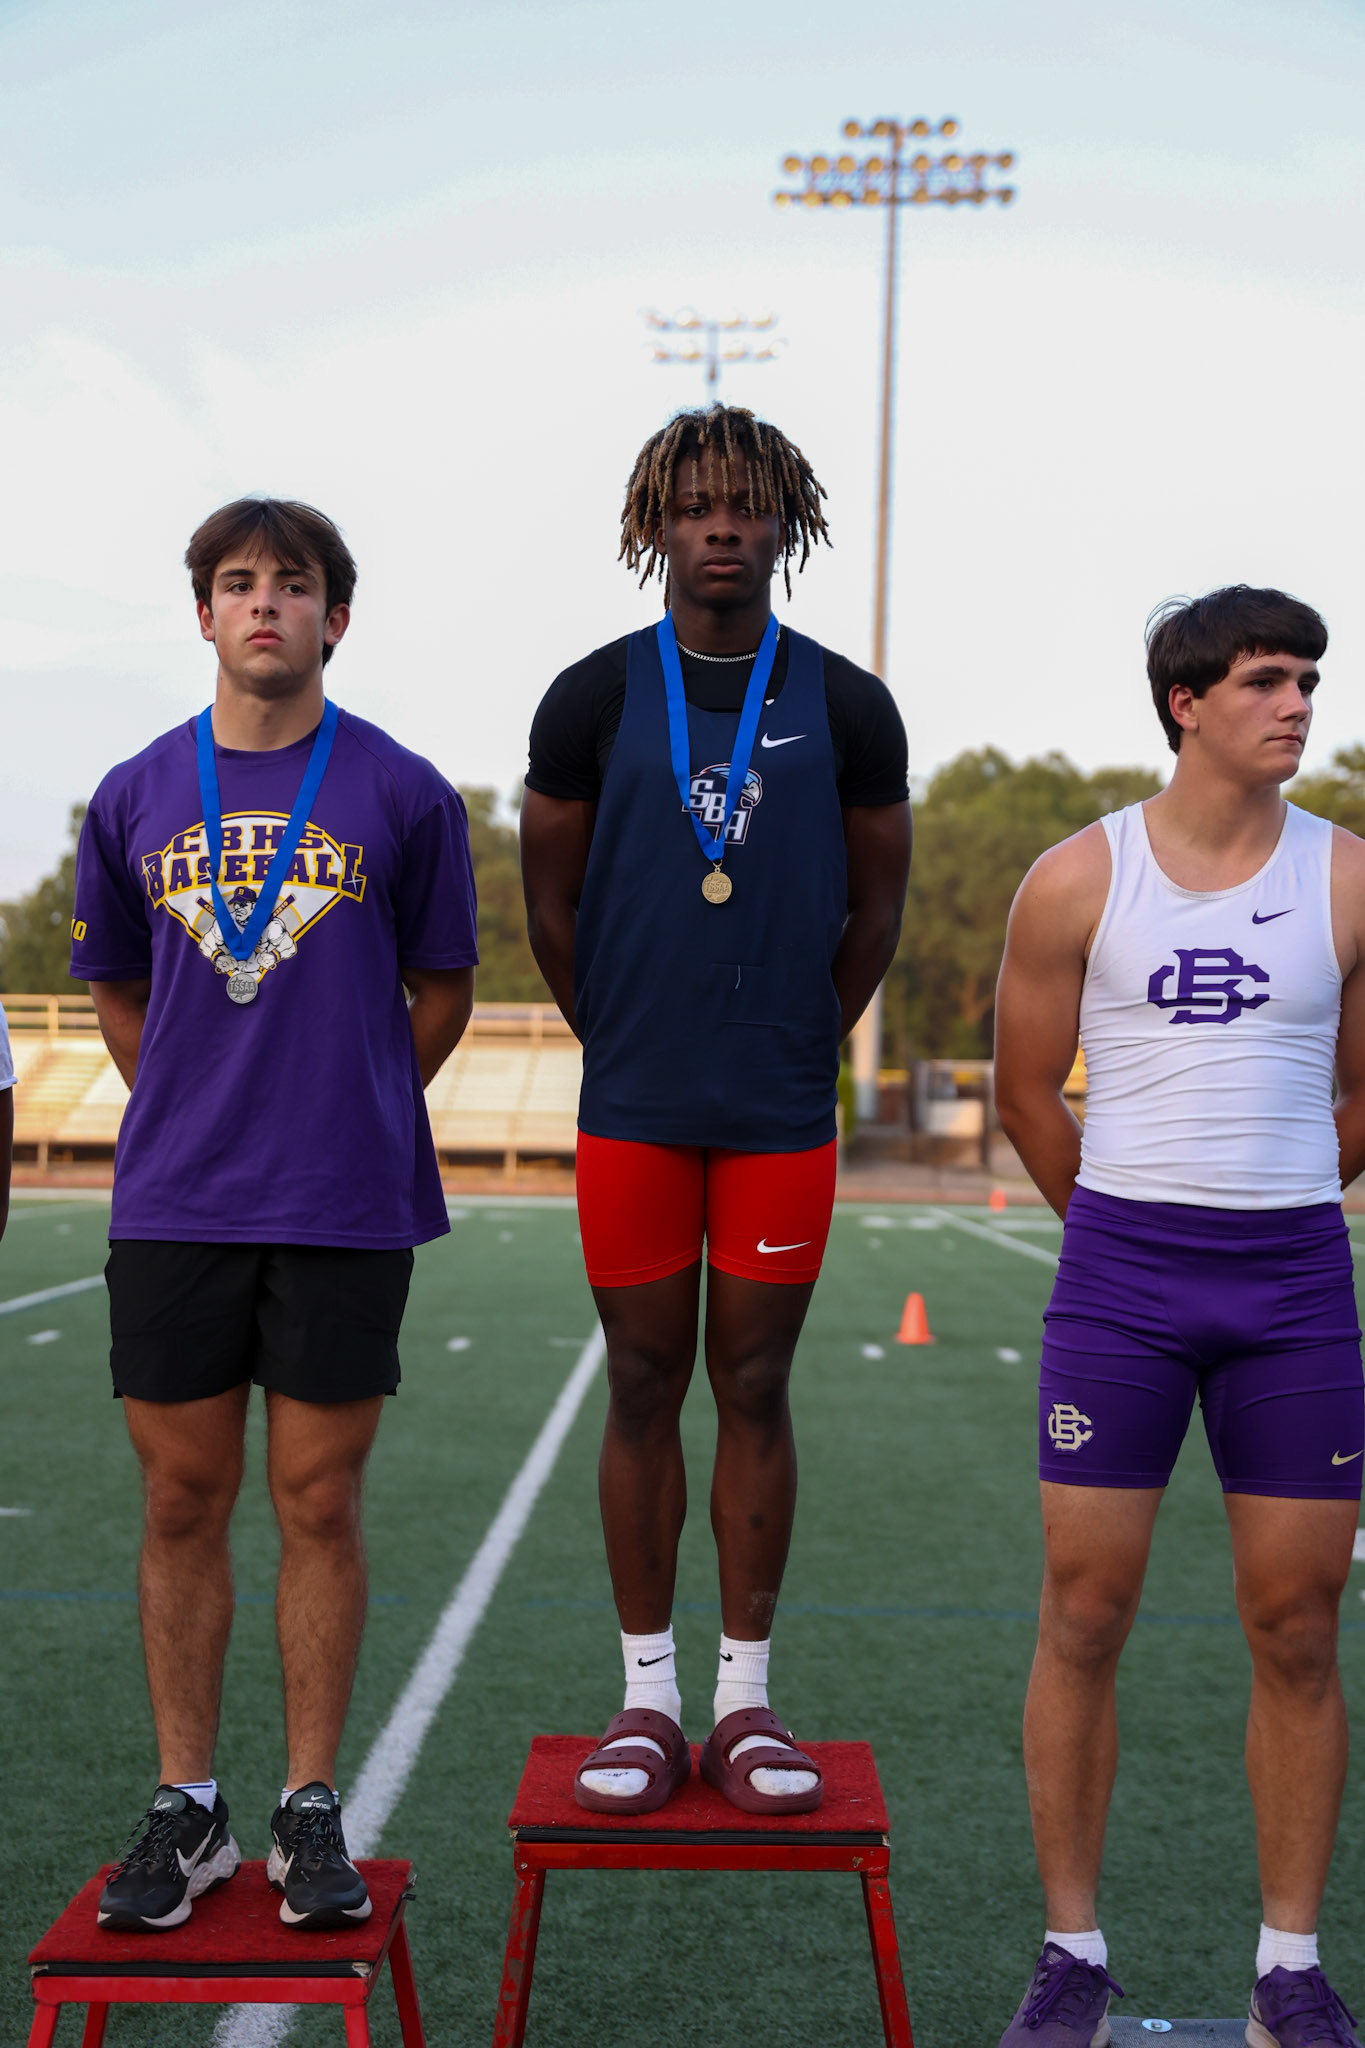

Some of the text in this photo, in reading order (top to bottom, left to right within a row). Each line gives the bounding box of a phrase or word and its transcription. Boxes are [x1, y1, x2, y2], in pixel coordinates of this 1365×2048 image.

[688, 779, 749, 841] SBA
[172, 825, 325, 853] CBHS
[229, 980, 255, 992] TSSAA
